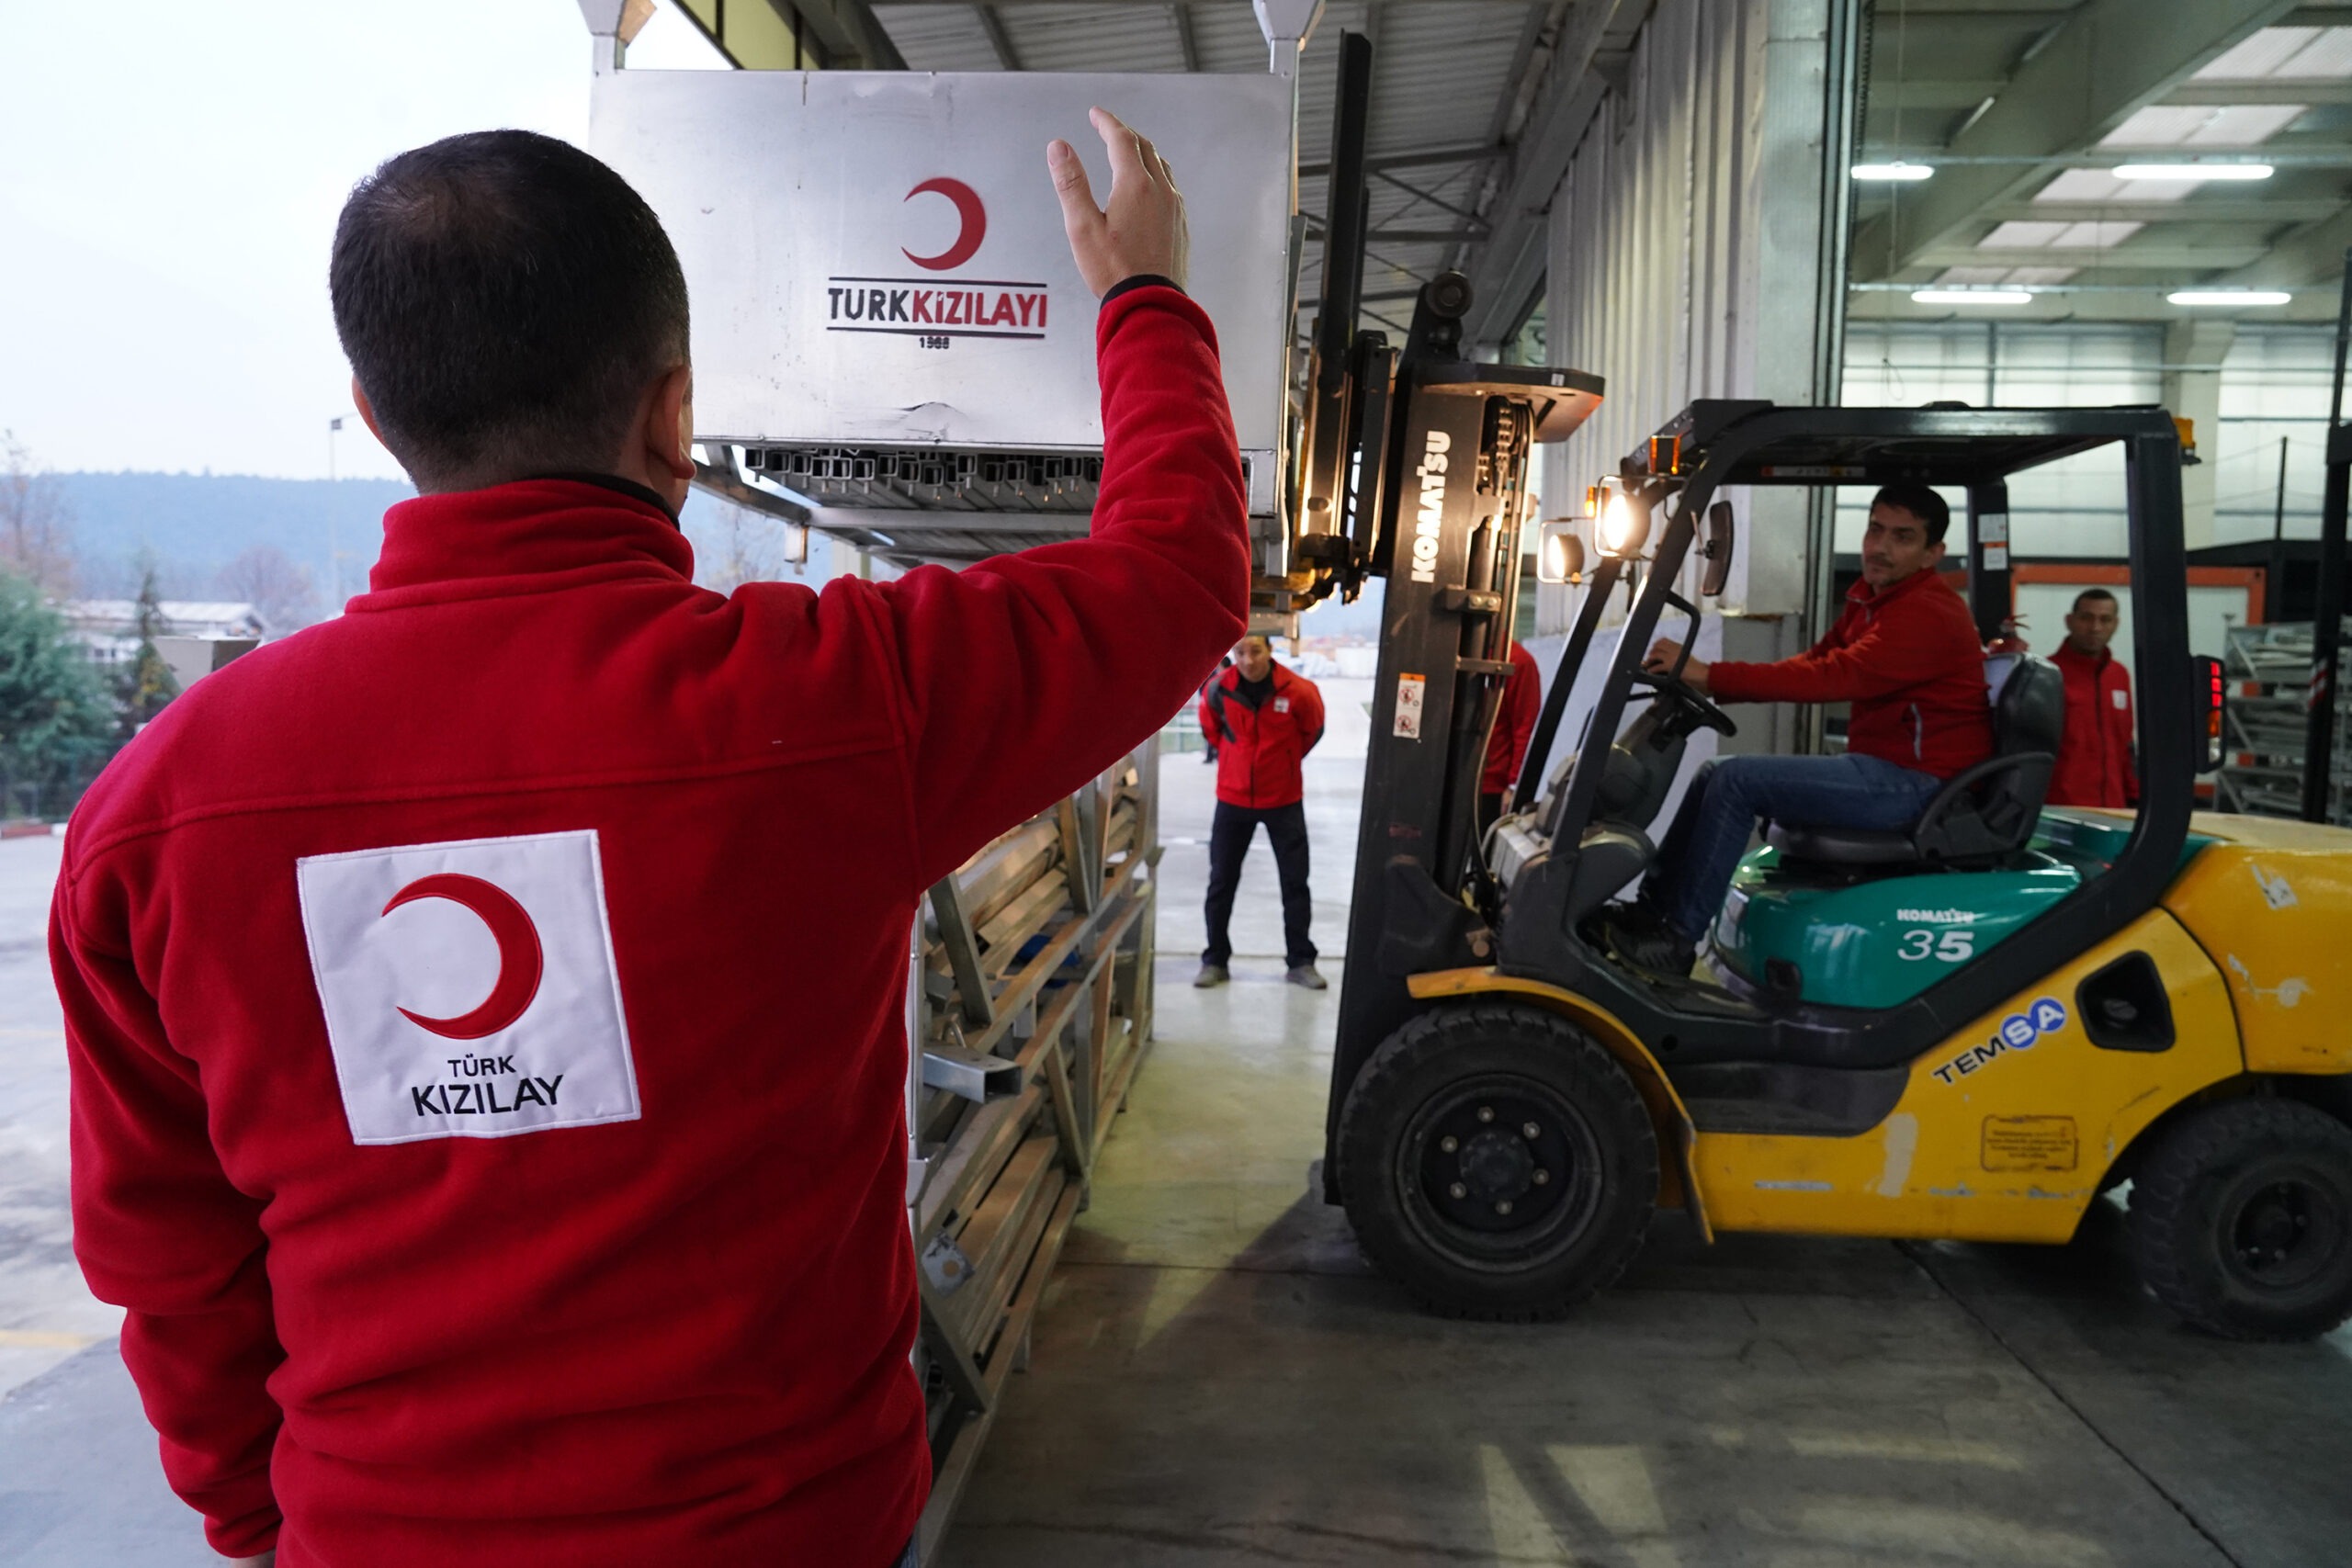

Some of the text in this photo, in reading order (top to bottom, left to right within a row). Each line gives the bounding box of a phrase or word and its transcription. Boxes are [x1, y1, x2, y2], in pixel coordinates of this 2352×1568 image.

[1897, 930, 1974, 962] 35
[1933, 1001, 2064, 1084] TEMSA
[447, 1054, 517, 1077] TÜRK
[412, 1075, 564, 1116] KIZILAY
